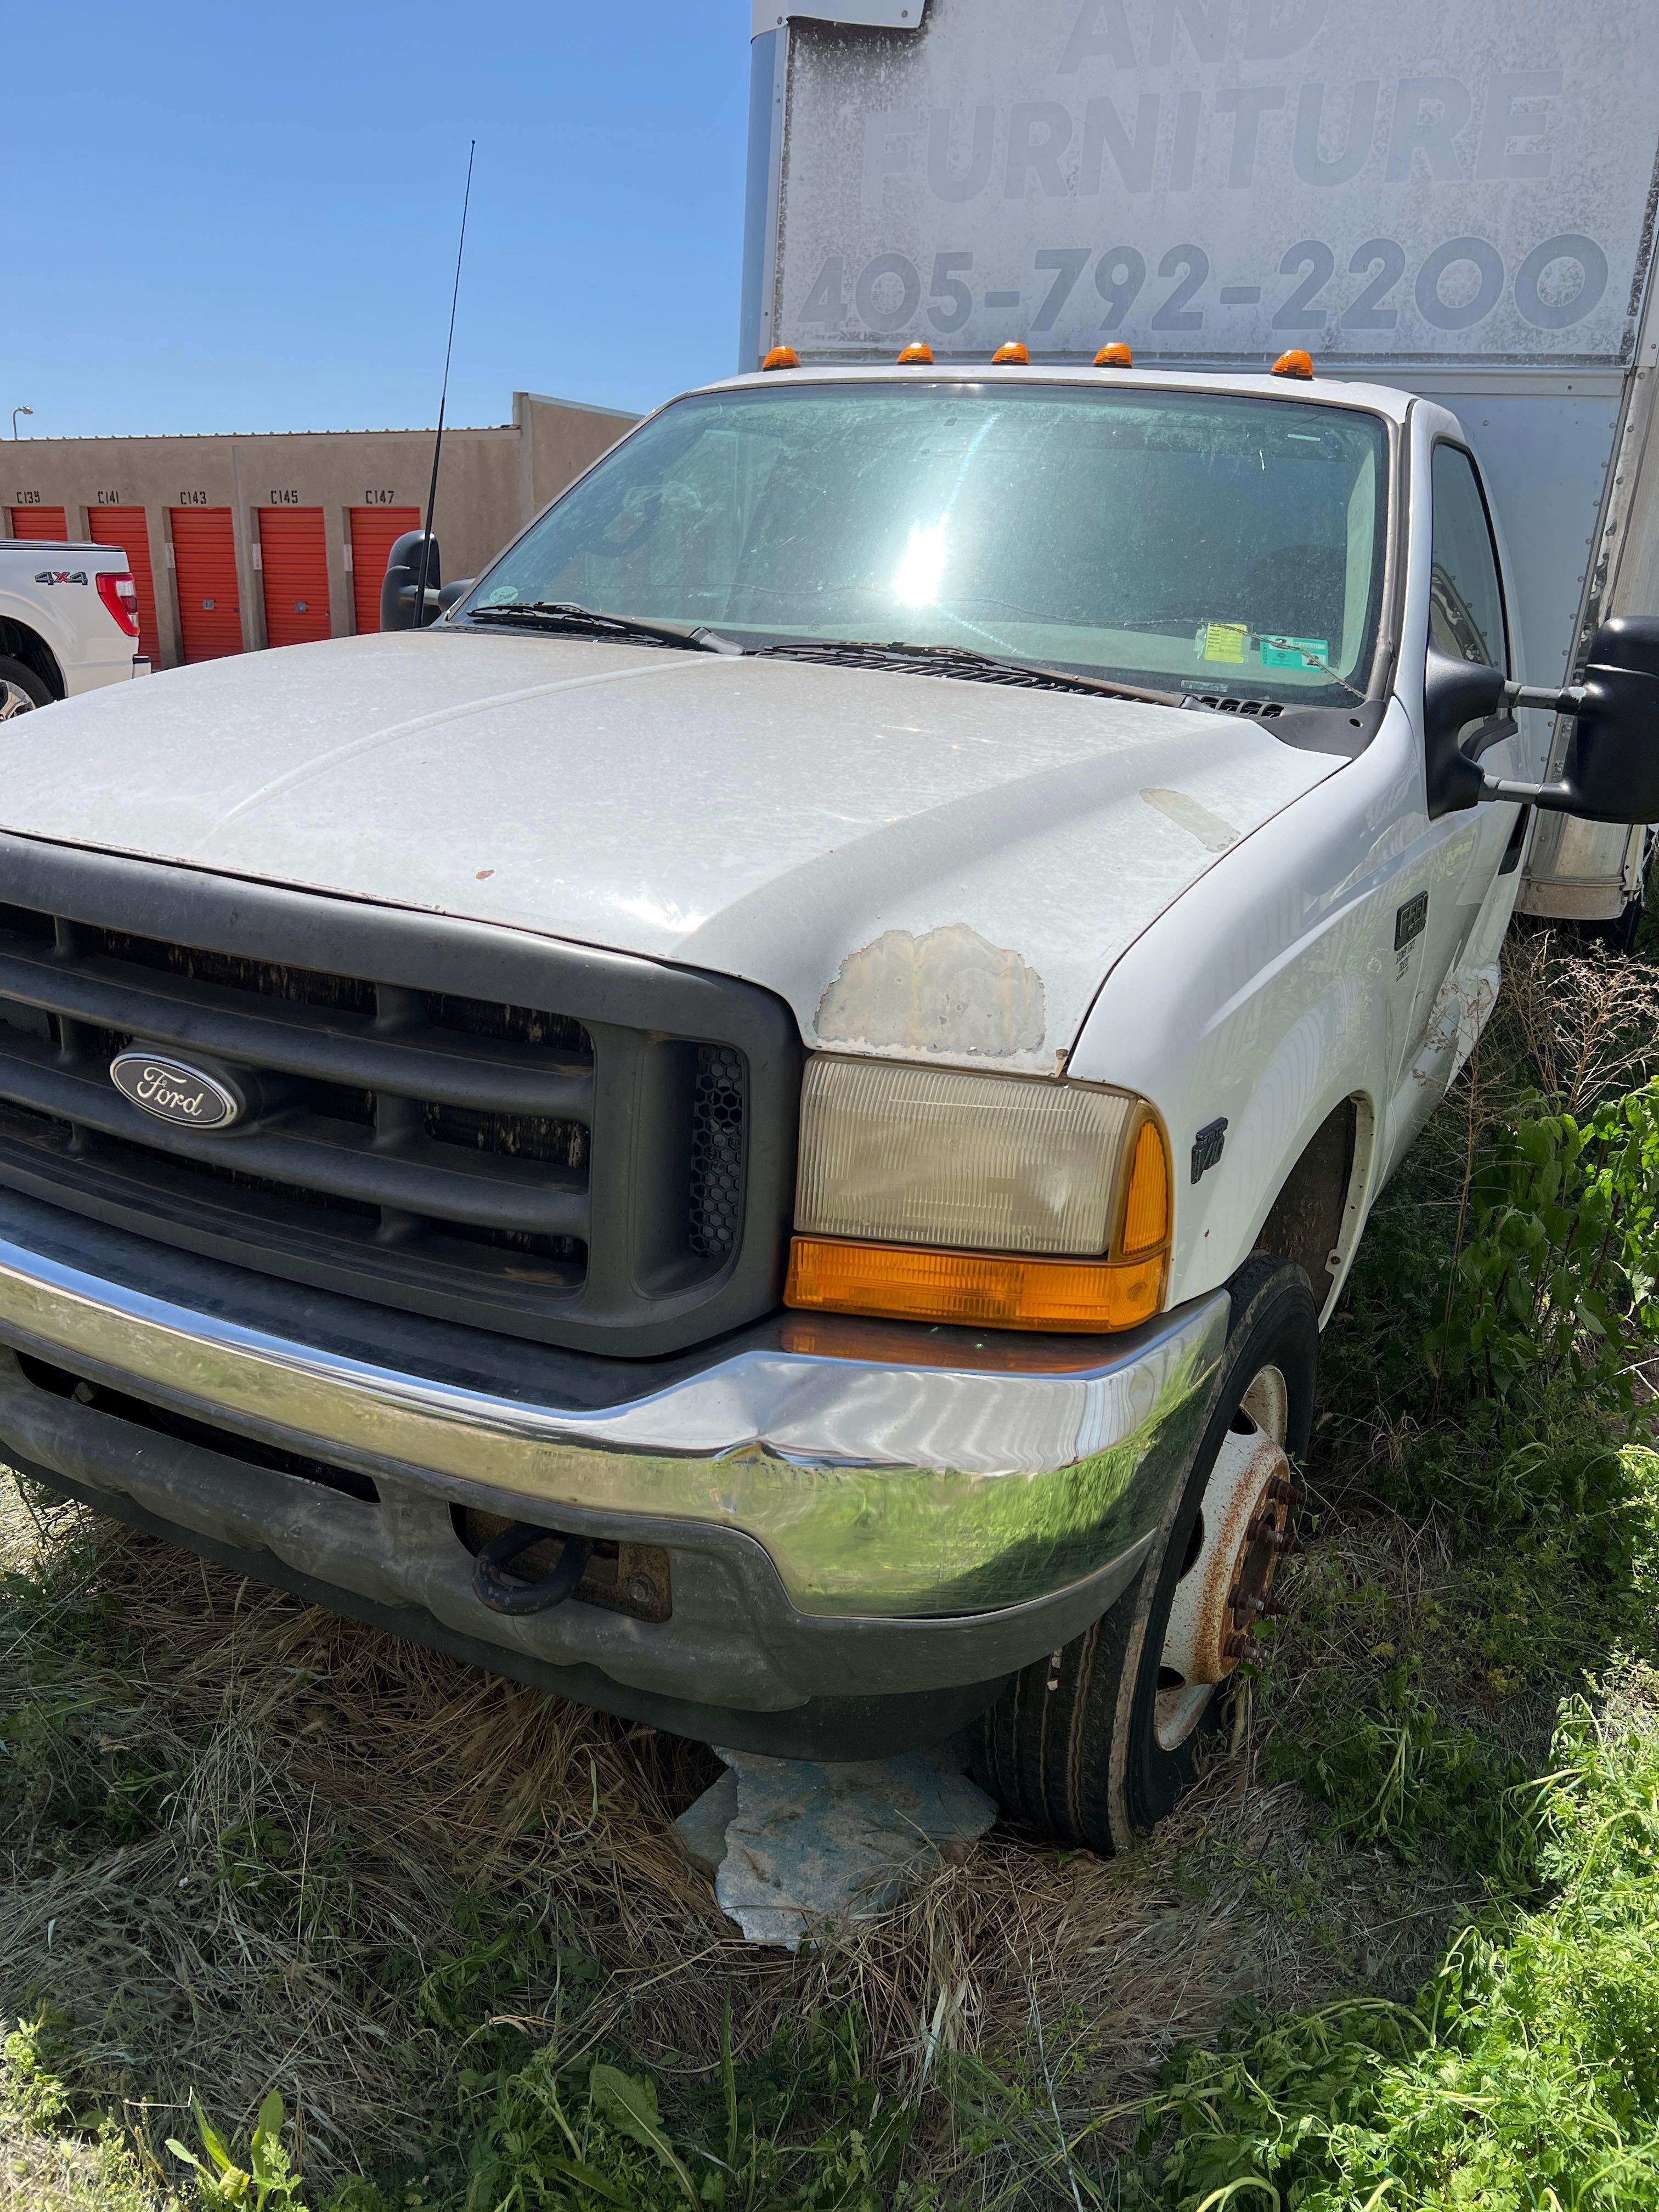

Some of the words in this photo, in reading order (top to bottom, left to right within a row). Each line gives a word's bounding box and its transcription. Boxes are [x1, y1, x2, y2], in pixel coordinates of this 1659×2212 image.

[1056, 0, 1331, 75] AND
[862, 70, 1564, 206] FURNITURE
[797, 233, 1609, 334] 405-792-2200
[16, 490, 40, 504] C139
[98, 490, 120, 504] C141
[180, 491, 207, 505] C143
[271, 490, 298, 504] C145
[365, 490, 394, 504] C147
[136, 1066, 204, 1116] Ford
